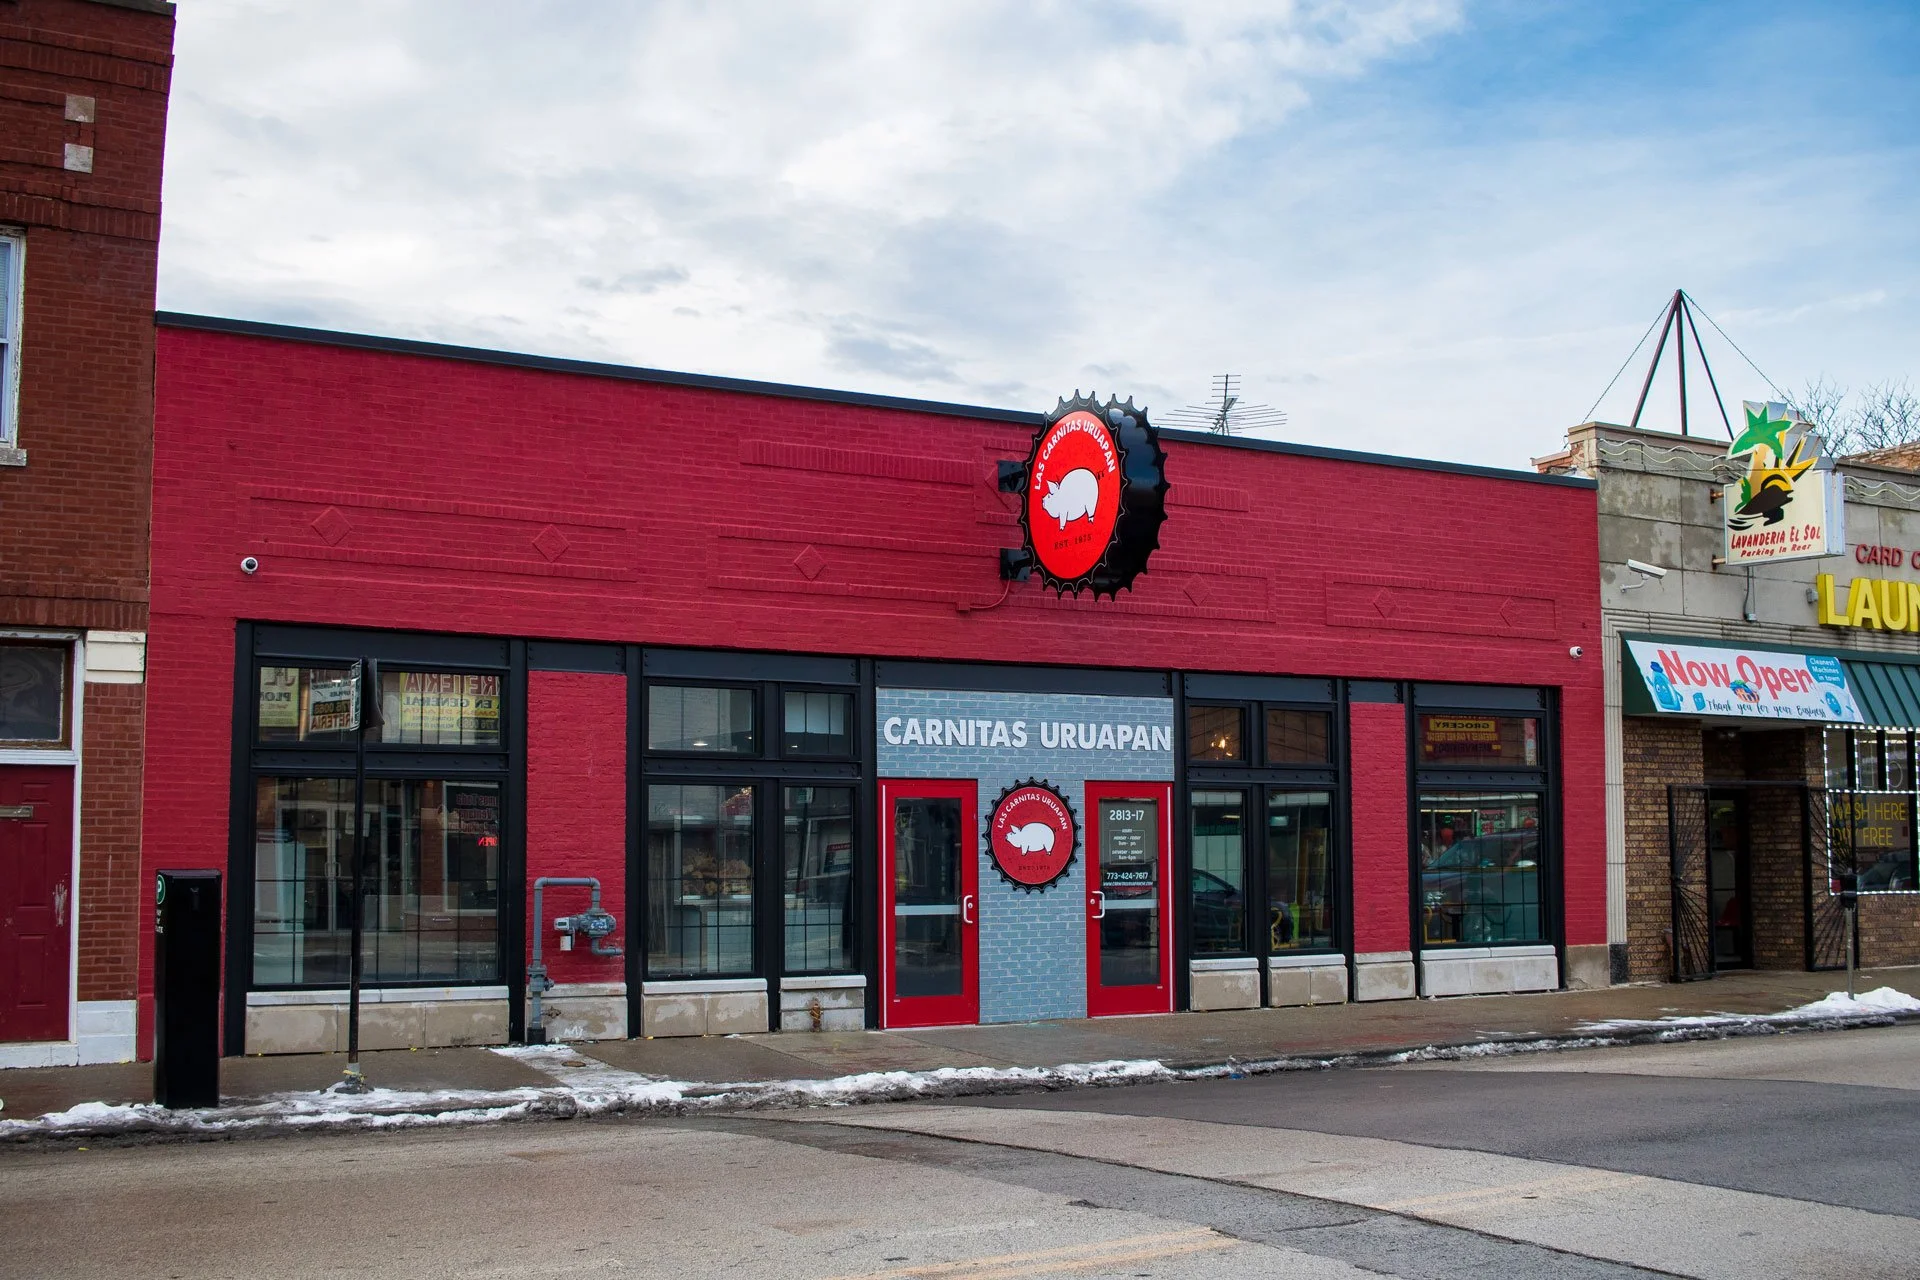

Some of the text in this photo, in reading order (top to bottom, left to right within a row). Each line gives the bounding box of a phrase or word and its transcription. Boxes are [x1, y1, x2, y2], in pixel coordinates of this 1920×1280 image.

[1034, 419, 1116, 490] LAS CARNITAS URUAPAN
[1731, 530, 1786, 550] LAVANDERIA
[1740, 548, 1774, 558] Parking
[1791, 544, 1812, 552] Rear
[1856, 544, 1904, 567] CARD
[1809, 658, 1835, 667] Cleanest
[1812, 666, 1840, 675] Machines
[1657, 649, 1814, 700] Now Open
[1825, 674, 1841, 682] town
[1706, 699, 1731, 711] Thank
[1737, 704, 1752, 715] you
[1756, 703, 1769, 714] for
[1773, 705, 1792, 717] your
[883, 716, 1172, 751] CARNITAS URUAPAN
[997, 793, 1068, 830] LAS CARNITAS URUAPAN
[1109, 809, 1144, 821] 2813-17
[1830, 802, 1906, 821] WASH HERE
[1862, 827, 1894, 846] FREE
[1106, 872, 1148, 880] 773-424-7617
